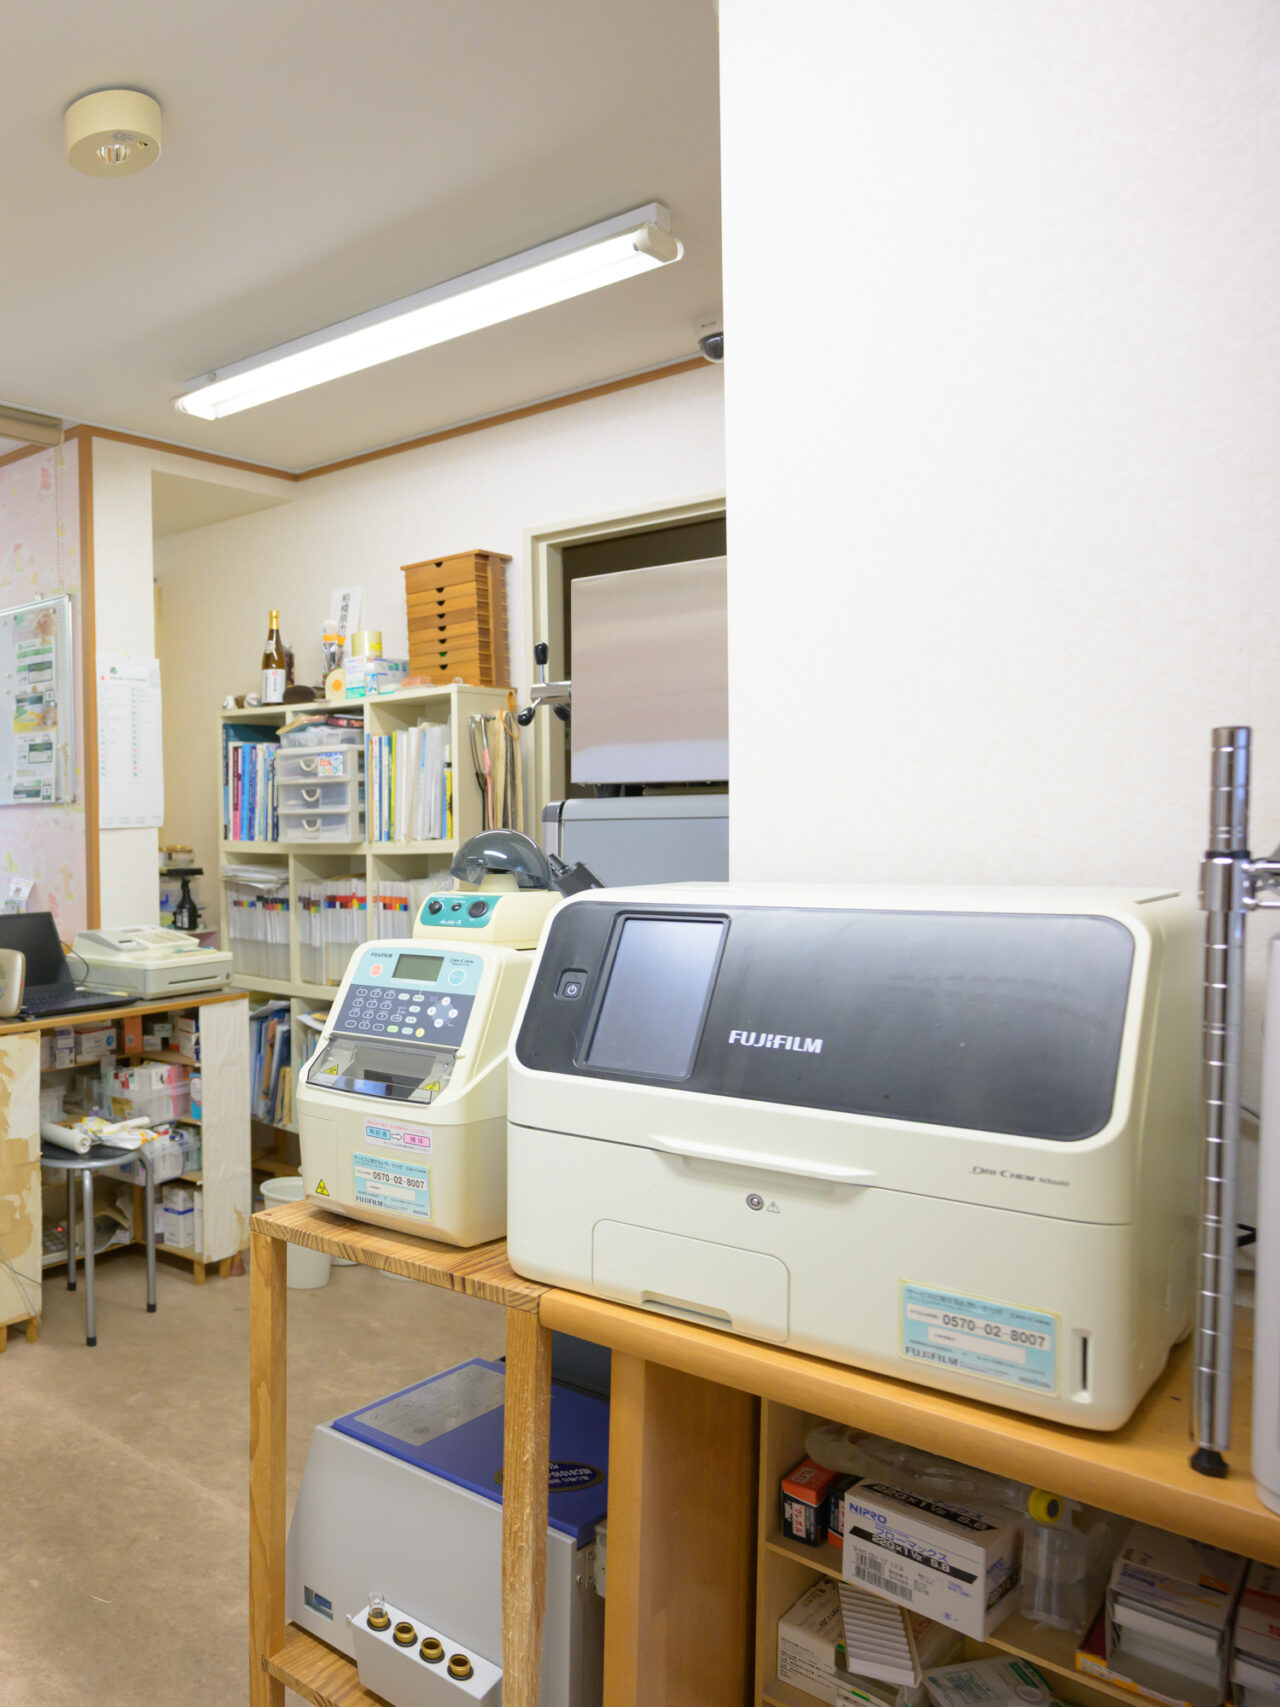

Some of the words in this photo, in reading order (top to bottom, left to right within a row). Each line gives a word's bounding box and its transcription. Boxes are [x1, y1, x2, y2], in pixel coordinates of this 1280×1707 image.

[728, 1029, 823, 1054] FUJIFILM
[372, 1171, 424, 1189] 0570-02-8007
[356, 1196, 383, 1207] FUJIFILM
[942, 1313, 1046, 1348] 0570-02-8007
[905, 1345, 958, 1366] FUJIFILM
[849, 1502, 888, 1525] NIPRO
[874, 1526, 948, 1563] フローマックス
